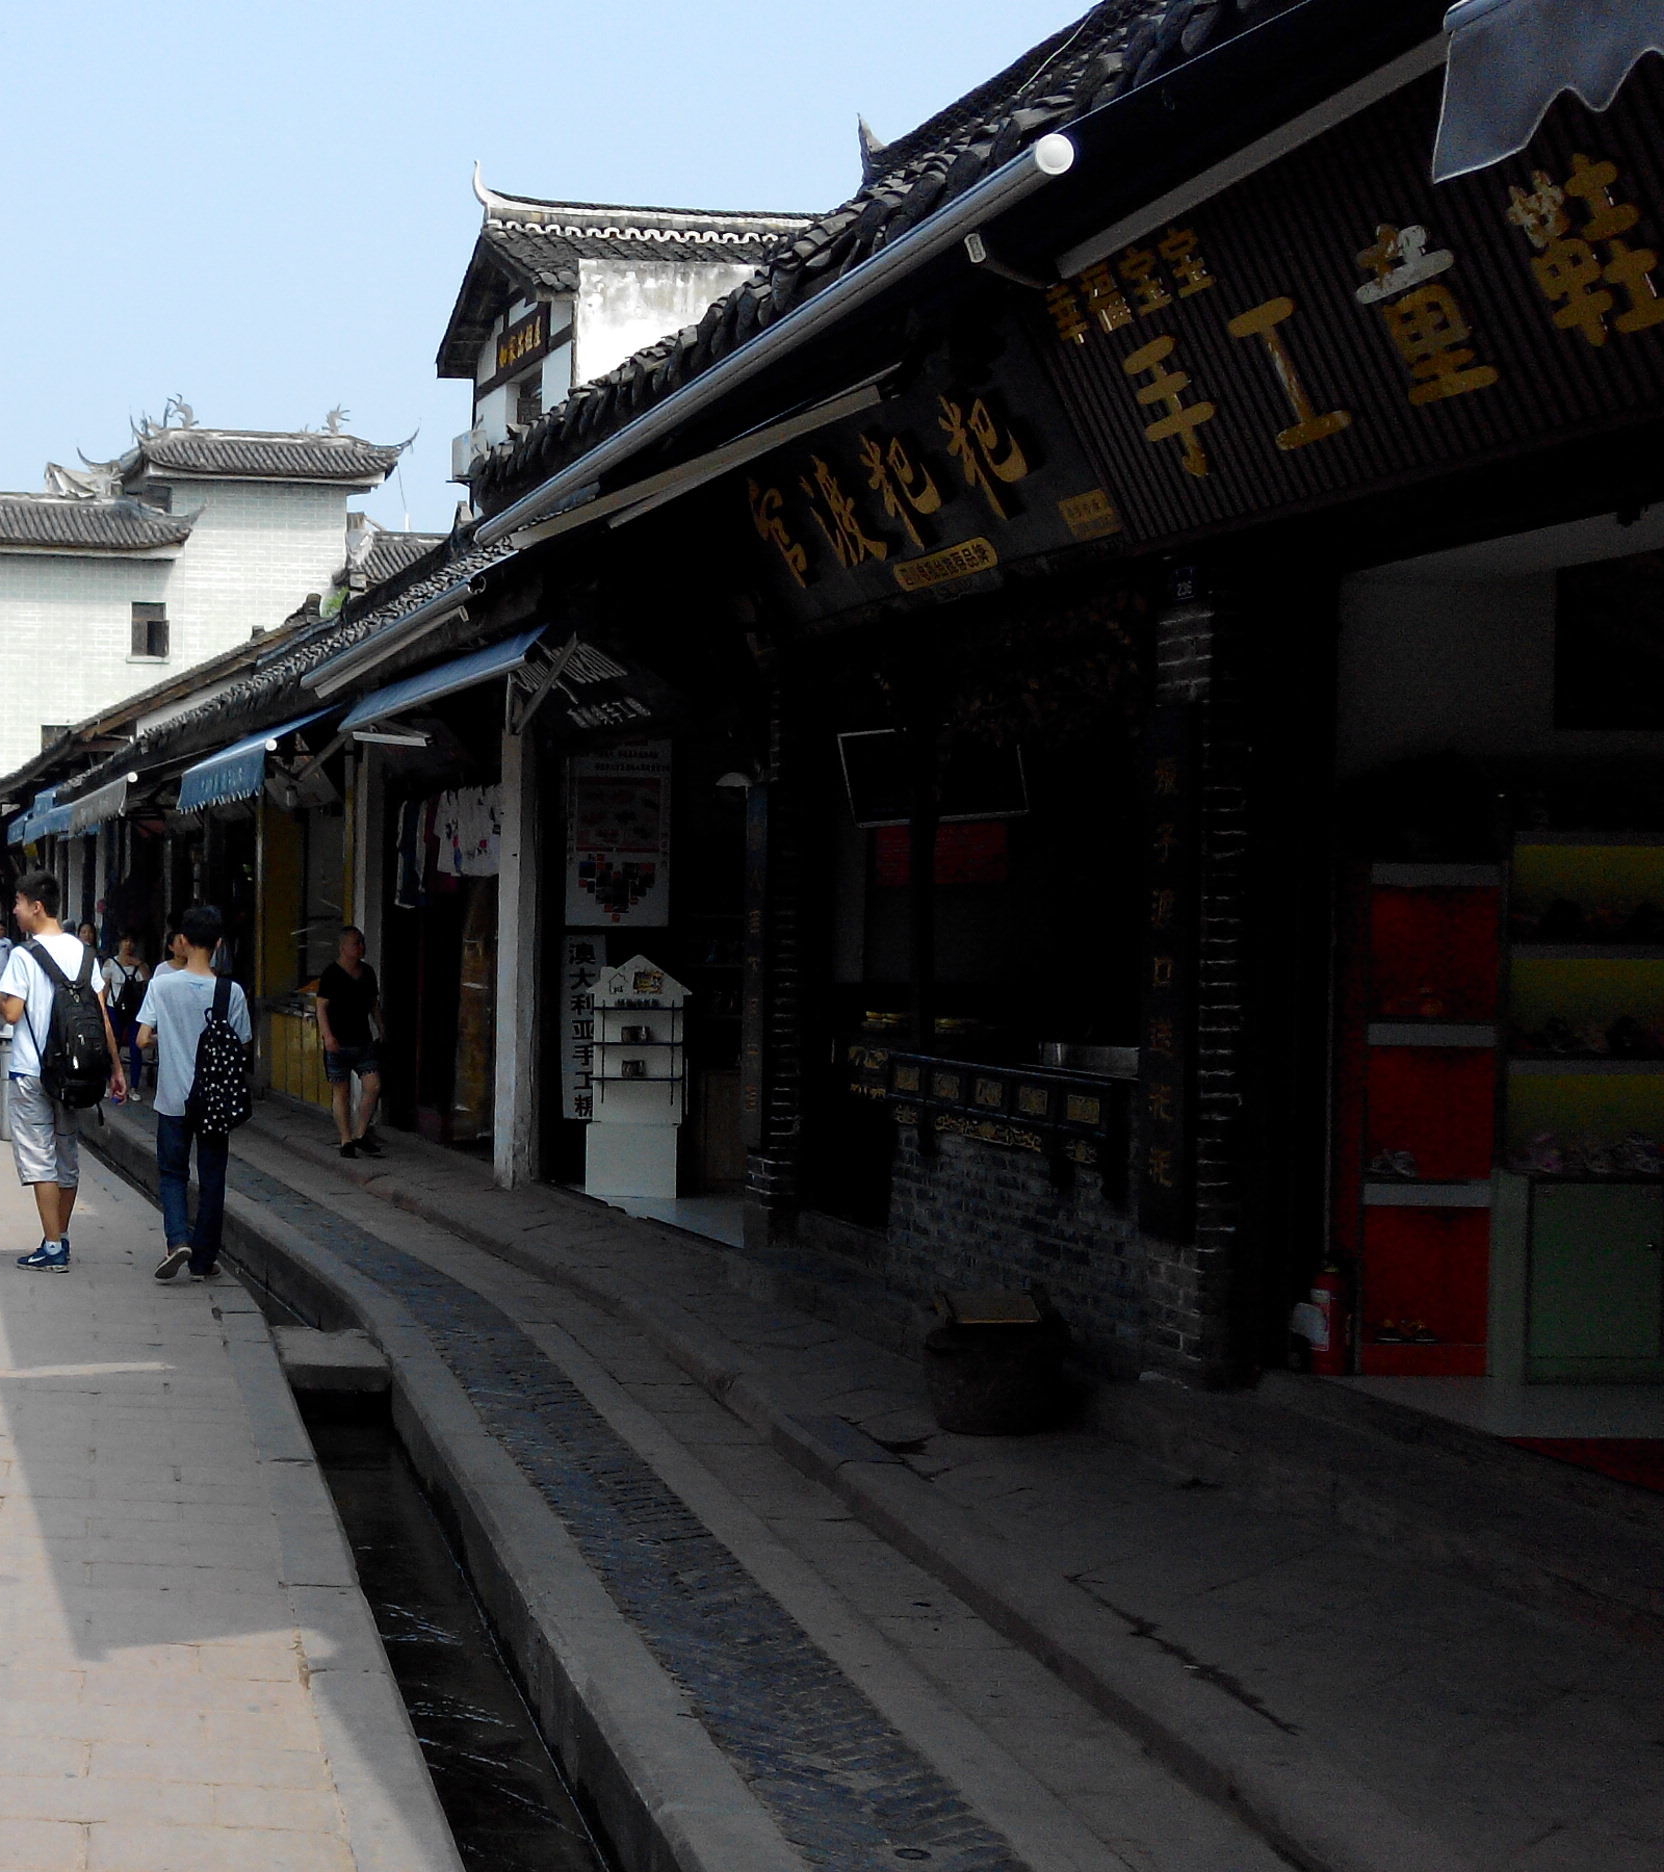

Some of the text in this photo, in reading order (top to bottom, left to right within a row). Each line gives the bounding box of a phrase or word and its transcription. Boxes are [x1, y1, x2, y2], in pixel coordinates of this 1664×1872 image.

[1044, 226, 1217, 344] 幸福宝宝
[1123, 152, 1664, 478] 手工童鞋
